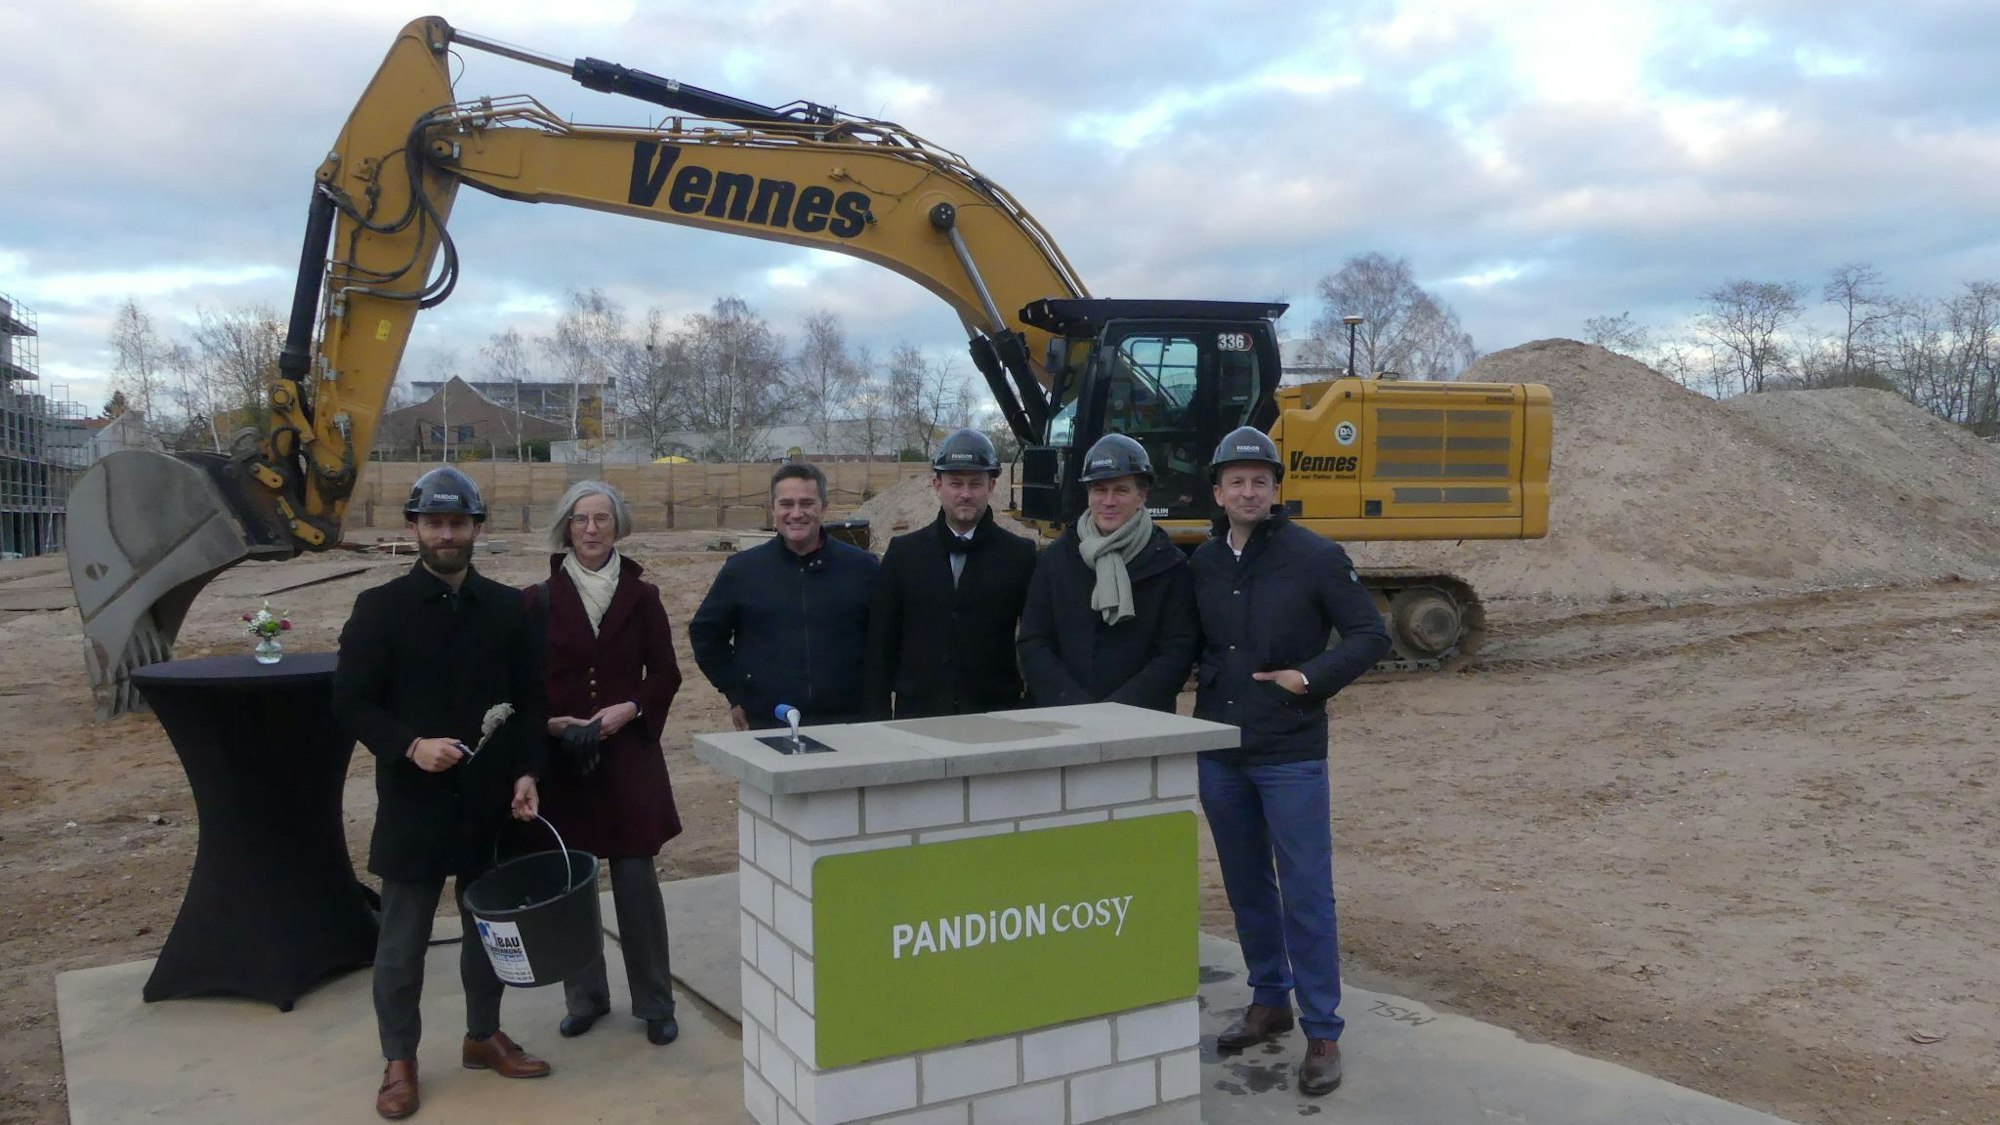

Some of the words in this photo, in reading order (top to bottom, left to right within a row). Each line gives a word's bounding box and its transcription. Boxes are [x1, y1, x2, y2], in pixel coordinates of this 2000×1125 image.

[628, 140, 871, 238] Vennes
[1218, 333, 1245, 350] 336
[1290, 451, 1357, 471] Vennes
[893, 903, 1047, 959] PANDiON
[1052, 895, 1134, 936] cosy
[497, 937, 520, 947] BAU
